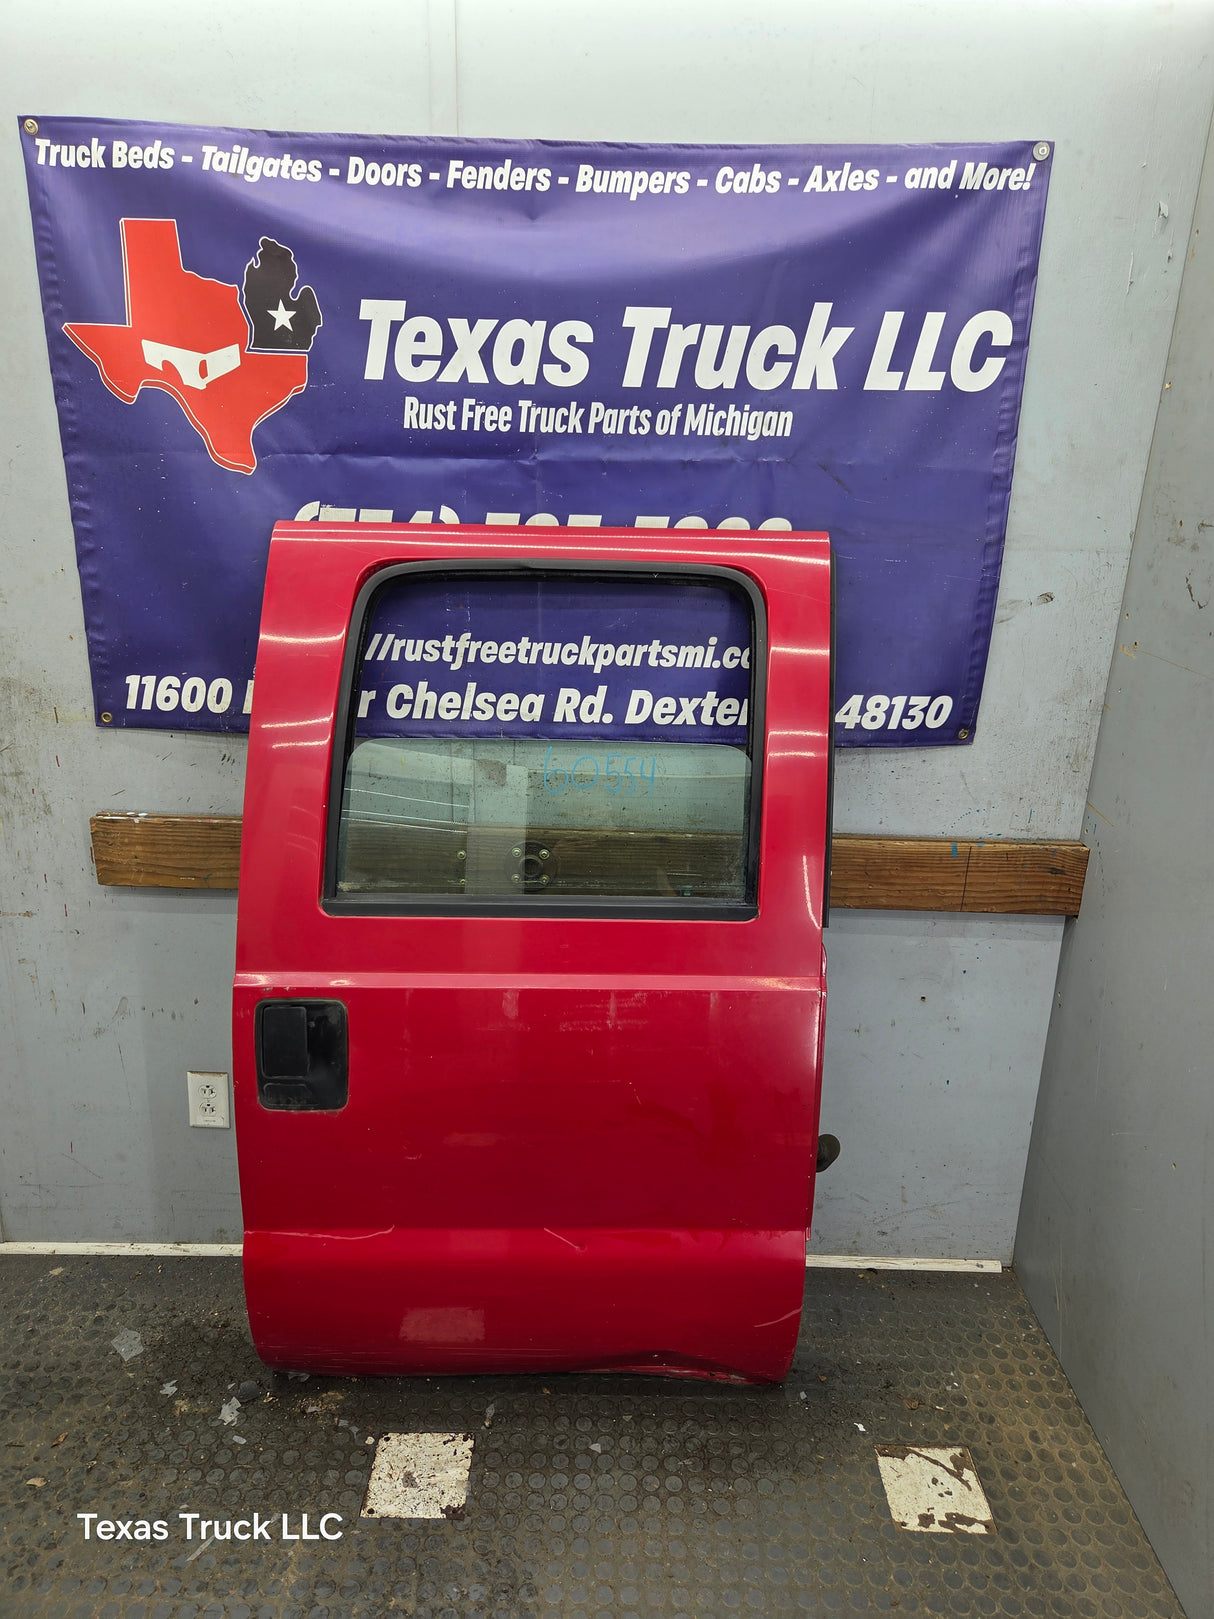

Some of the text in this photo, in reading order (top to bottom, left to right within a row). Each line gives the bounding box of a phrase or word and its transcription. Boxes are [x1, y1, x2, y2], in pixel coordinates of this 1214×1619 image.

[35, 137, 1037, 202] Truck Beds - Tailgates - Doors - Fenders - Bumpers - Cabs - Axles - and More!
[358, 298, 1014, 393] Texas Truck LLC
[403, 395, 794, 442] Rust Free Truck Parts of Michigan
[125, 674, 233, 714] 11600
[386, 680, 546, 723] Chelsea
[552, 684, 614, 724] Rd.
[834, 693, 954, 730] 48130
[543, 746, 656, 796] 60554
